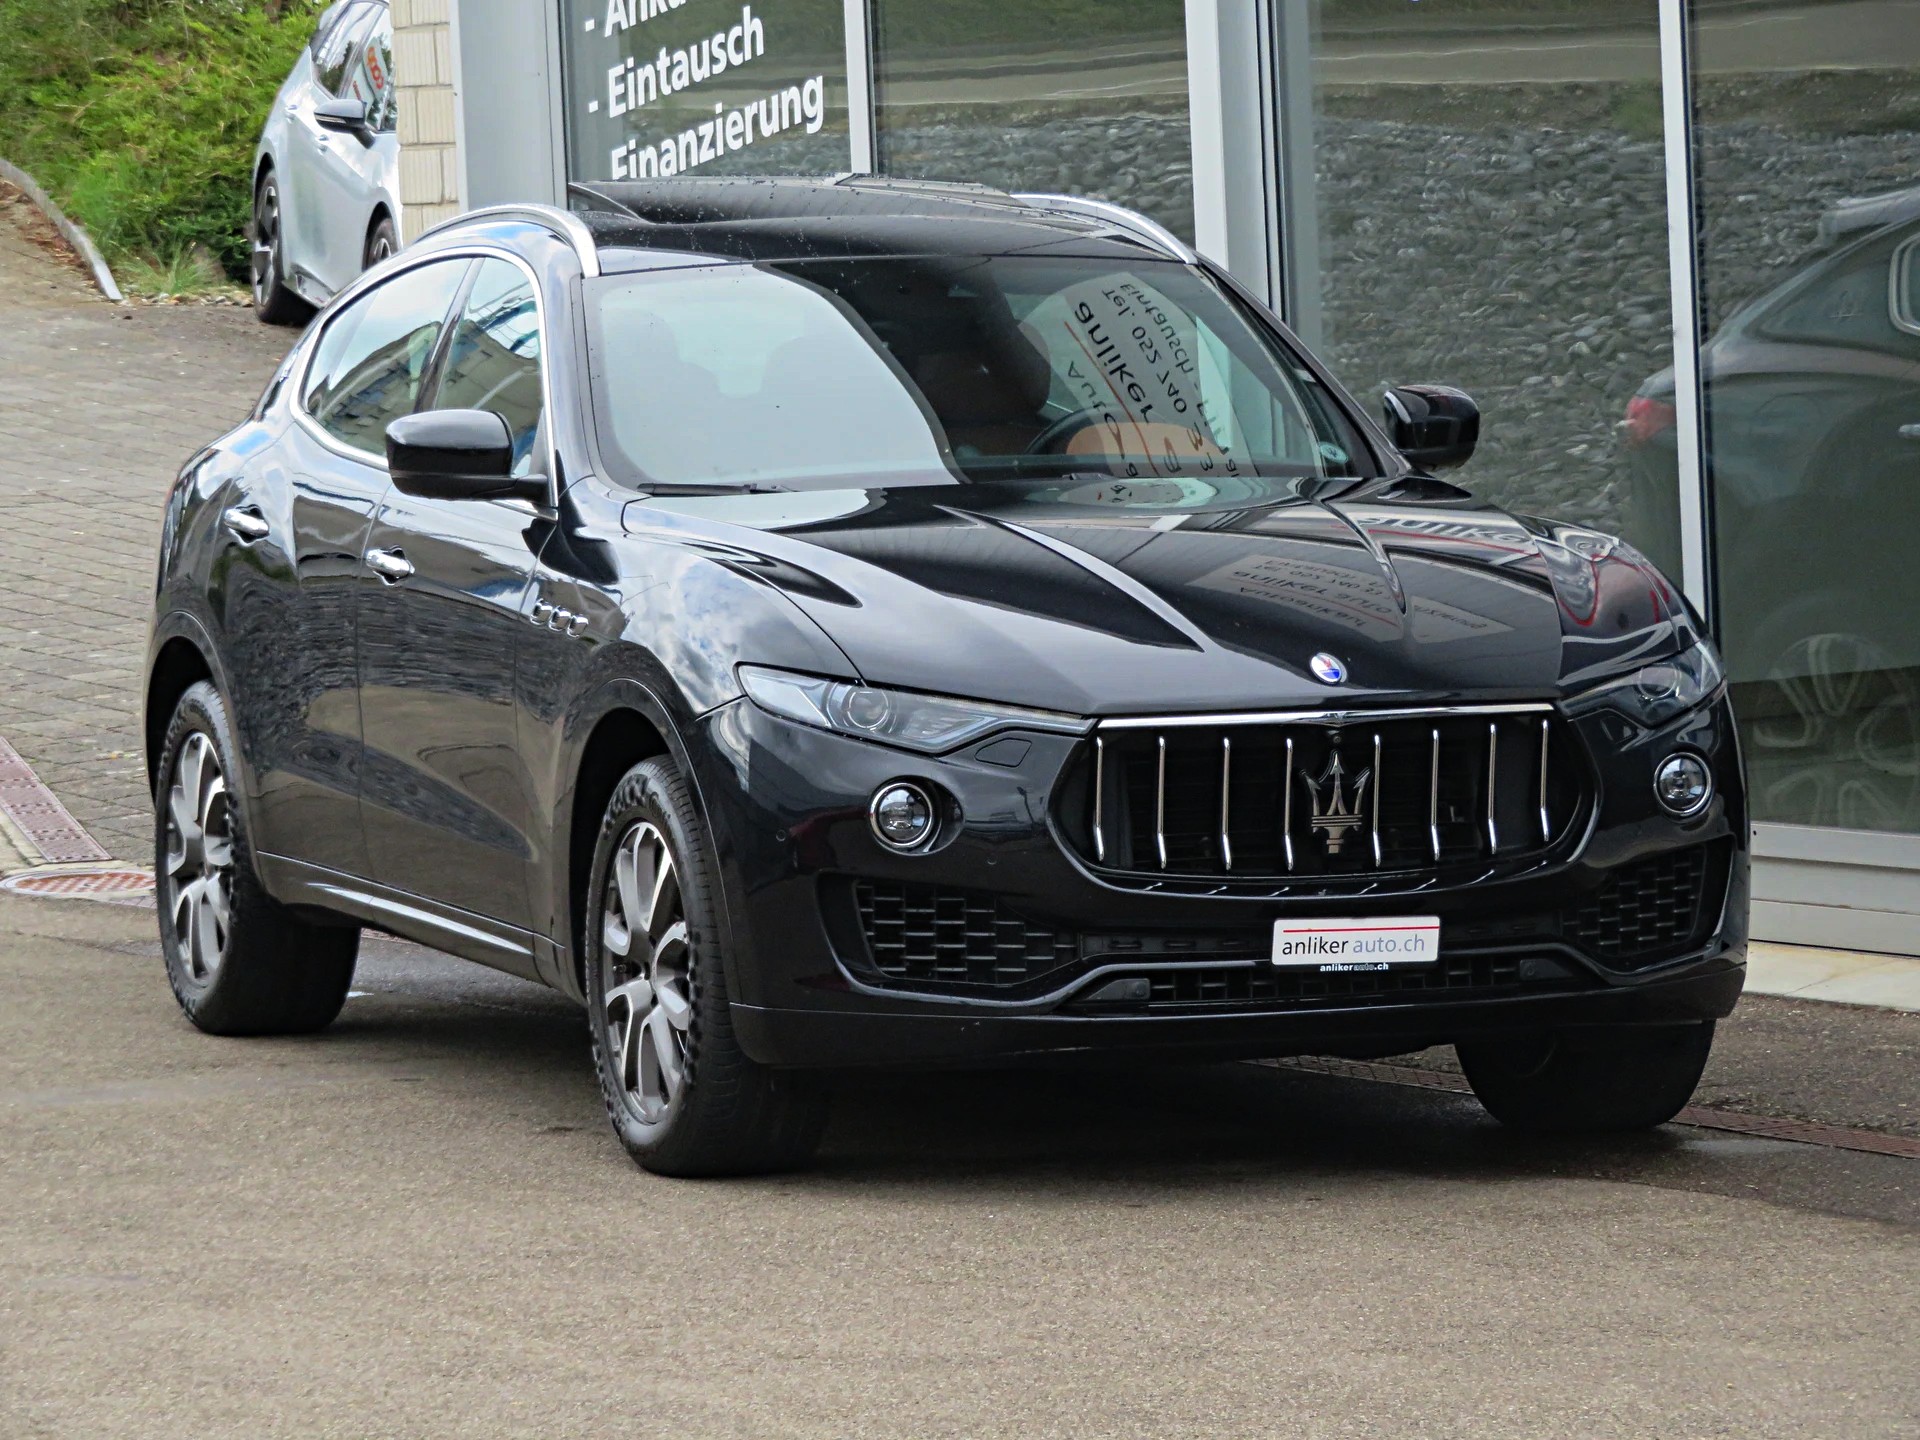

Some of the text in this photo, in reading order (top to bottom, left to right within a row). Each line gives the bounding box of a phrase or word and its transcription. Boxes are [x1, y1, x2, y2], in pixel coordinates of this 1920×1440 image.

[608, 5, 764, 118] Eintausch
[611, 75, 824, 181] Finanzierung
[1282, 934, 1425, 955] anliker auto.ch
